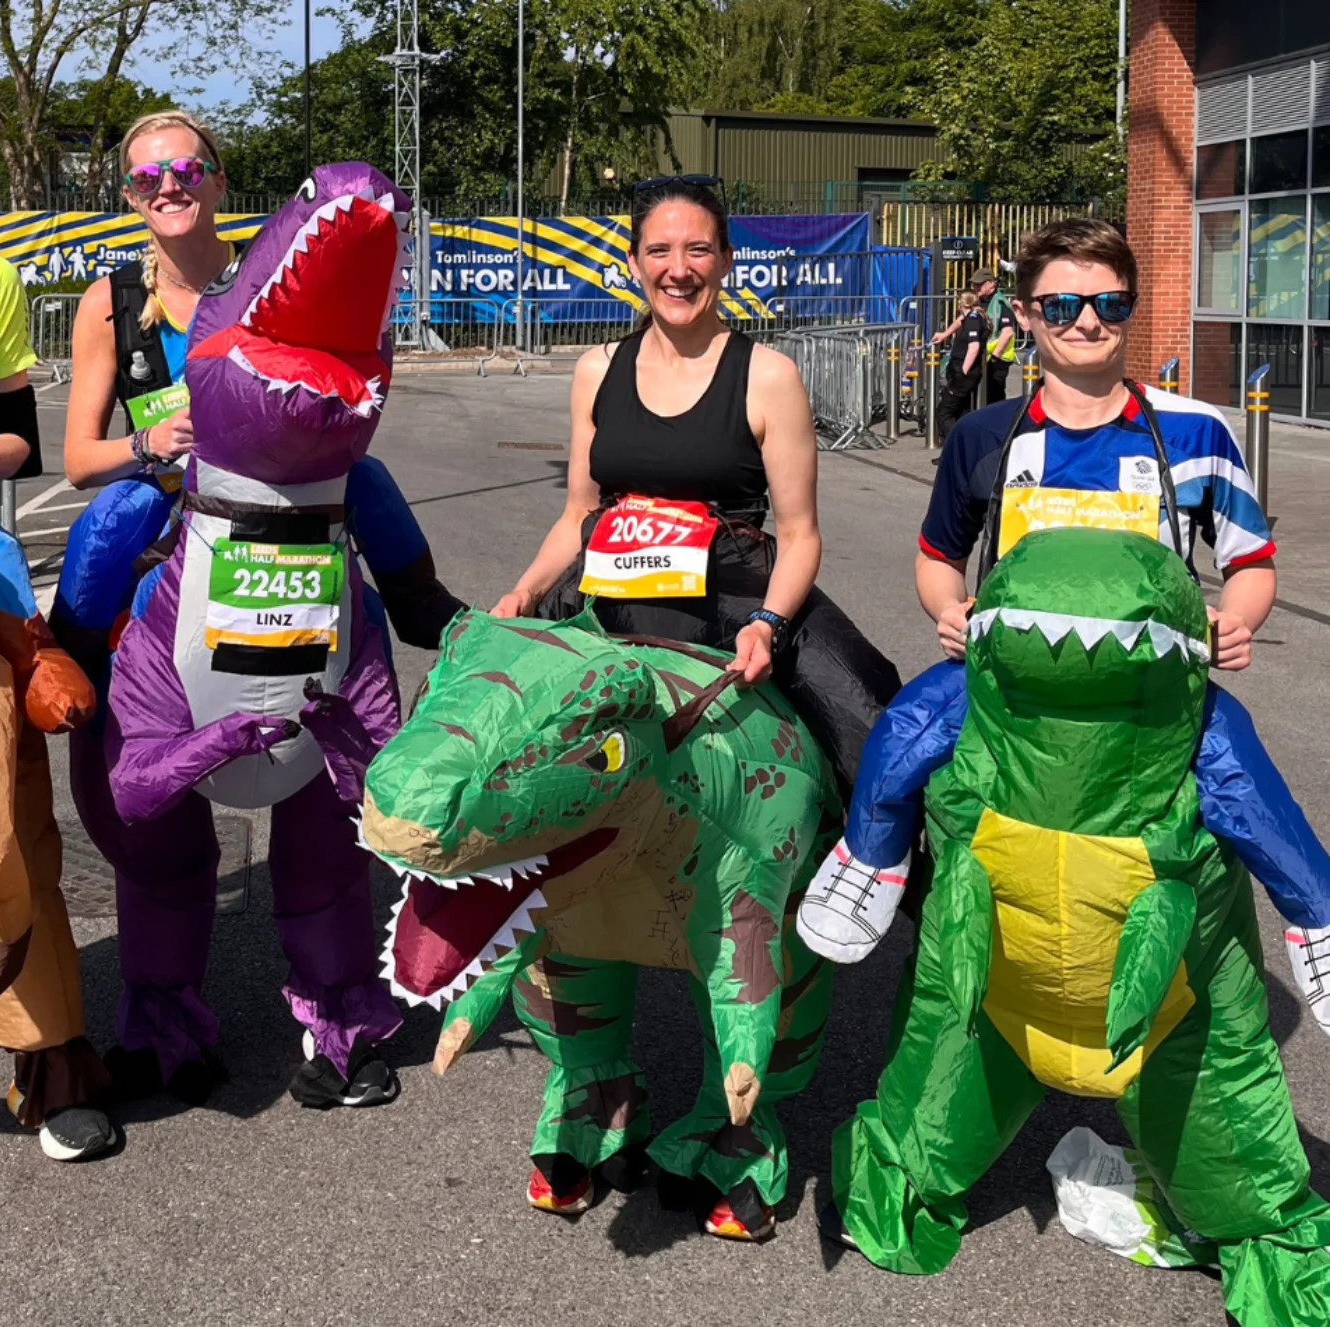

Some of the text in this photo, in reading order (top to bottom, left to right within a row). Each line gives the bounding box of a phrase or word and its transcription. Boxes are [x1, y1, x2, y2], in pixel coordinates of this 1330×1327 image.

[97, 246, 137, 261] Jane
[460, 268, 515, 292] FOR
[522, 267, 571, 291] ALL
[735, 264, 788, 288] FOR
[607, 516, 692, 544] 20677
[251, 554, 331, 564] HALF MARATHON
[614, 555, 671, 569] CUFFERS
[233, 568, 321, 599] 22453
[256, 613, 293, 626] LINZ
